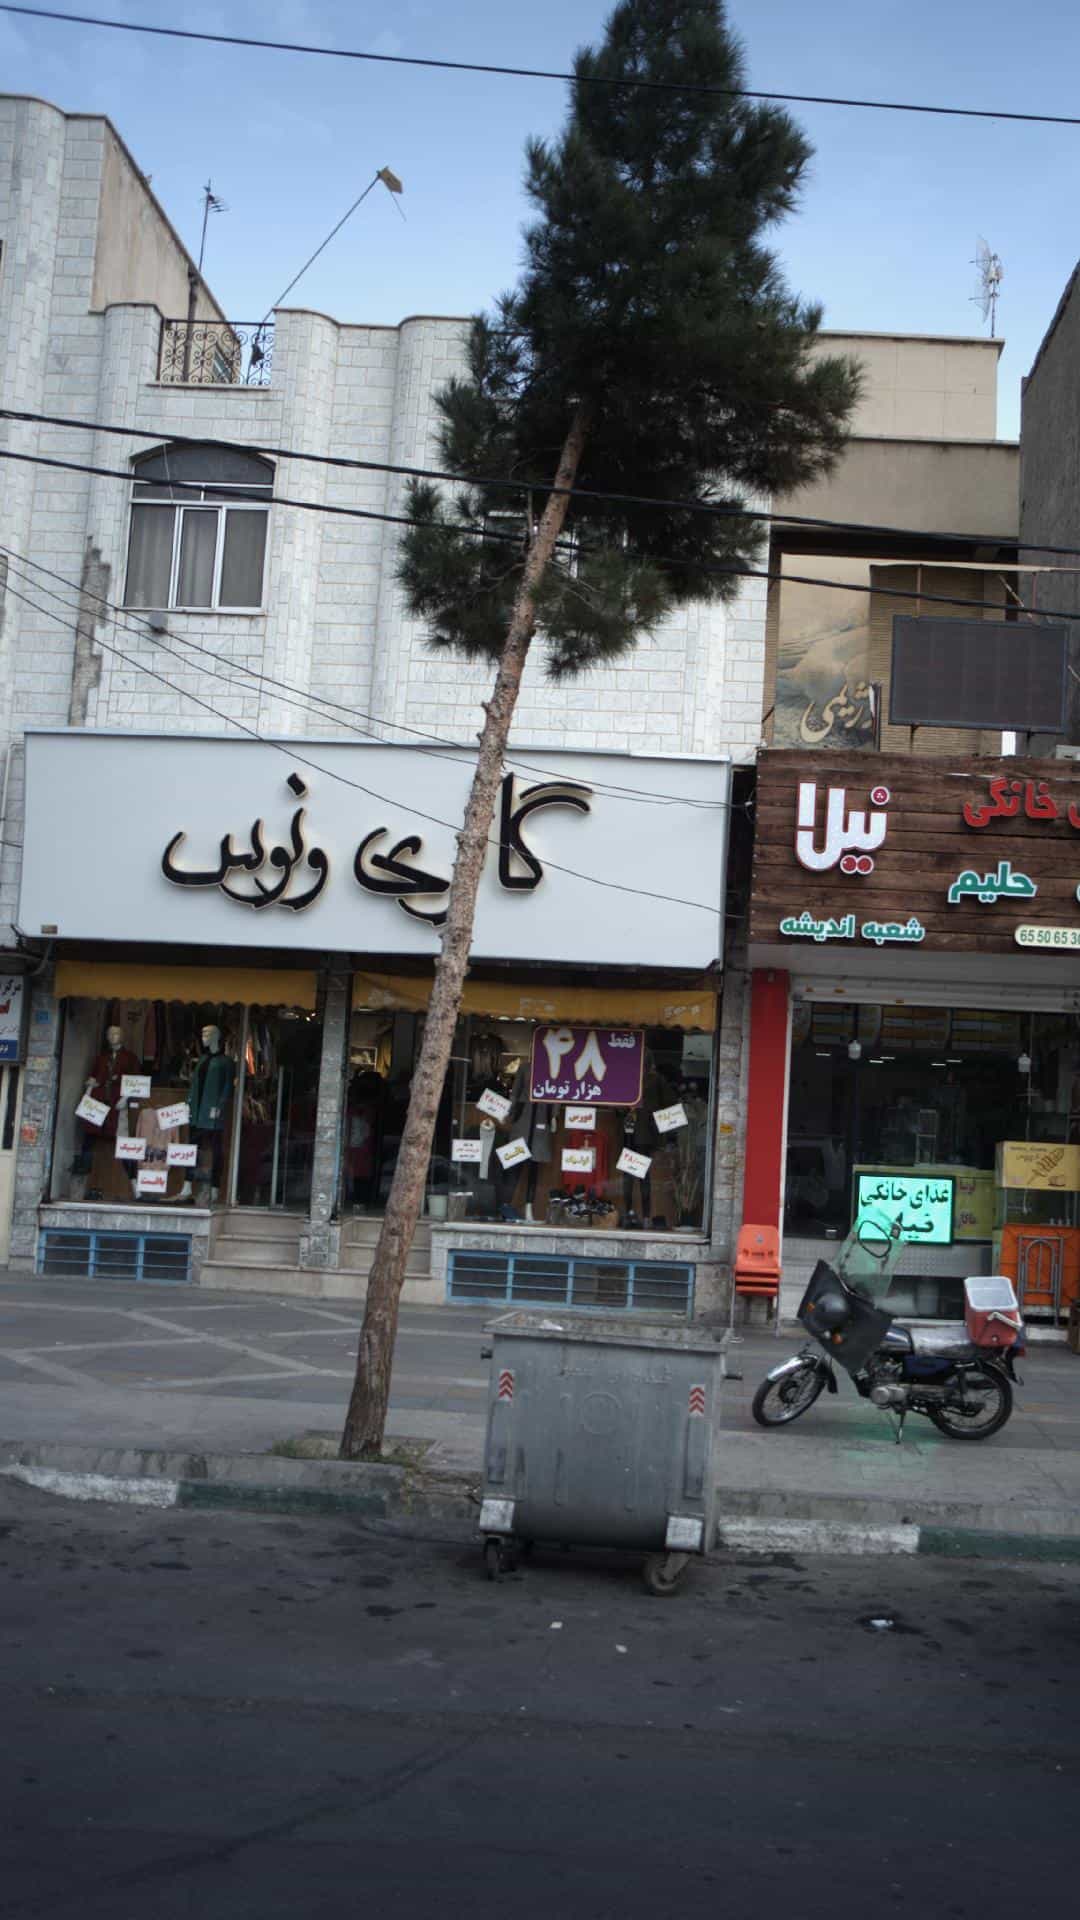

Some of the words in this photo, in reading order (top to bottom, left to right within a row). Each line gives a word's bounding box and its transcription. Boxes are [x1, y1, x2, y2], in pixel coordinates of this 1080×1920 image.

[963, 776, 1058, 828] خانگی
[161, 772, 329, 911] ونوس
[796, 780, 891, 875] نیلا
[354, 771, 593, 926] گاری
[948, 861, 1037, 904] حلیم
[780, 912, 856, 942] اندیشه
[861, 917, 925, 945] شعبه
[608, 1031, 636, 1049] فقط
[532, 1080, 570, 1099] تومان
[571, 1081, 602, 1100] هزار
[909, 1182, 950, 1210] غذای
